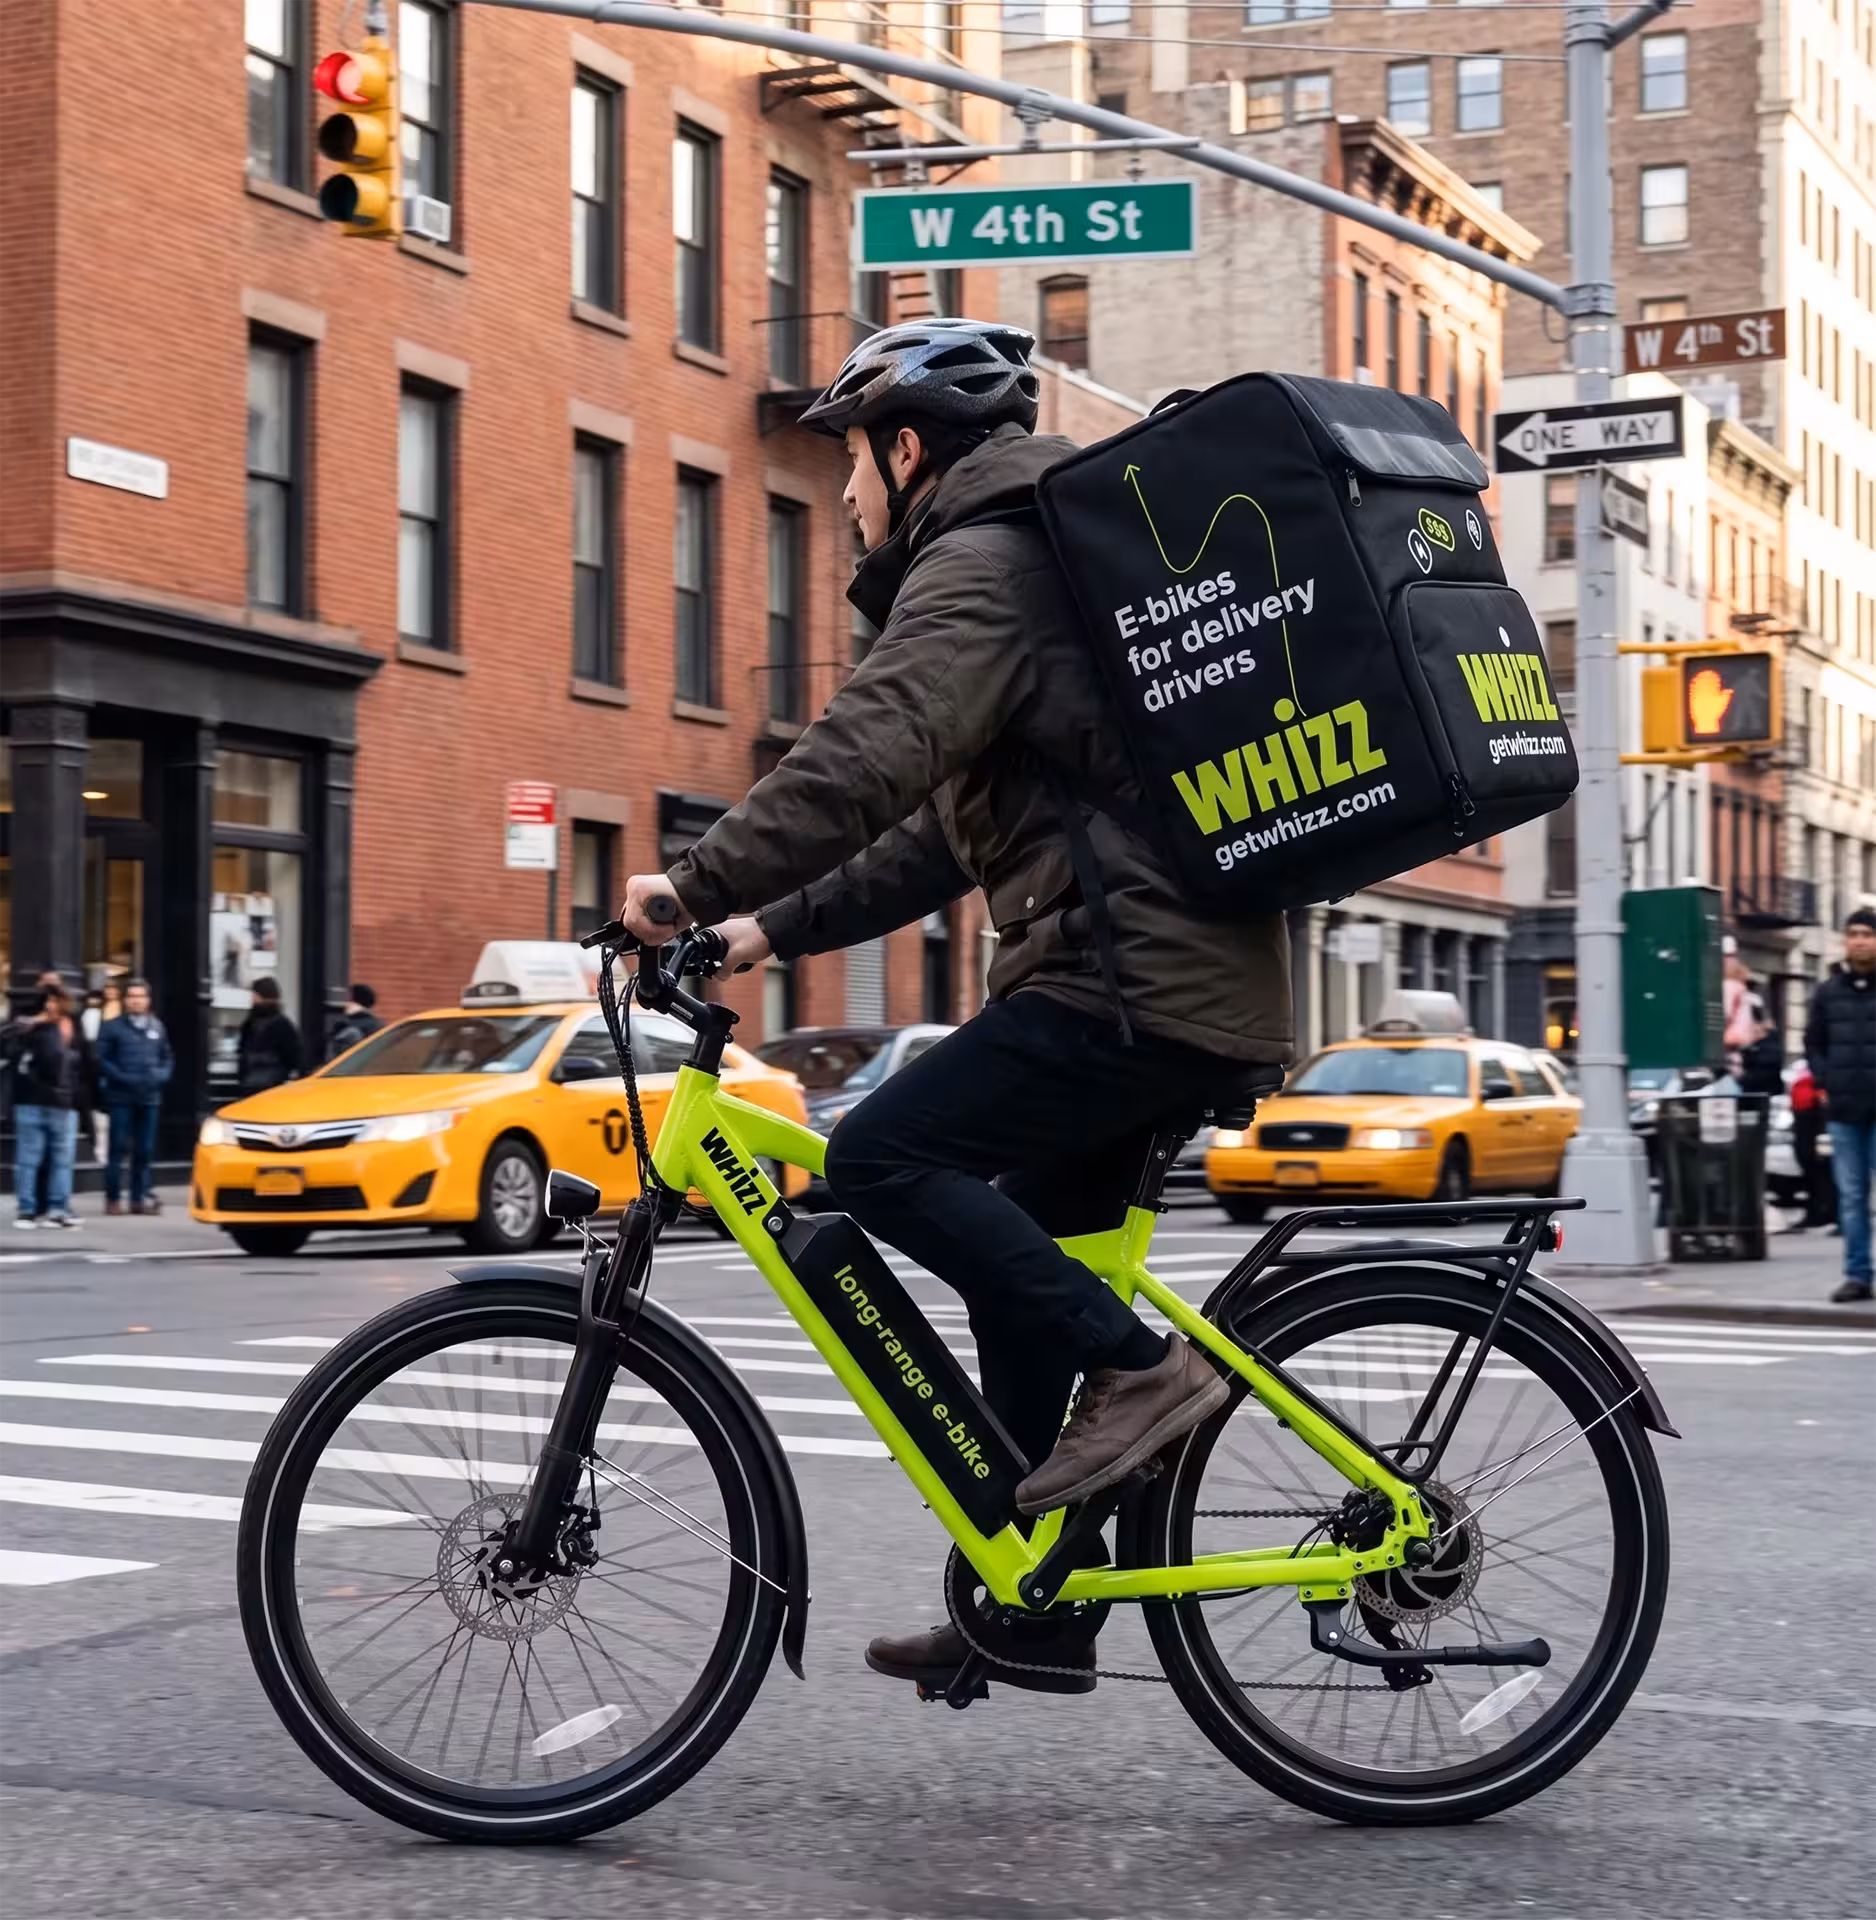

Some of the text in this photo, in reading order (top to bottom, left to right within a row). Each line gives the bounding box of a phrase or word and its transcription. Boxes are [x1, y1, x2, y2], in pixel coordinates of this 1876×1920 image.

[910, 200, 1142, 248] W 4th St
[1634, 317, 1774, 367] W 4th St
[1521, 416, 1661, 452] ONE WAY
[1114, 570, 1237, 640] E-bikes
[1127, 577, 1316, 677] for delivery
[1143, 648, 1257, 713] drivers
[1488, 730, 1567, 765] getwhizz.com
[1214, 781, 1397, 872] getwhizz.com
[833, 1264, 990, 1480] long-range e-bike
